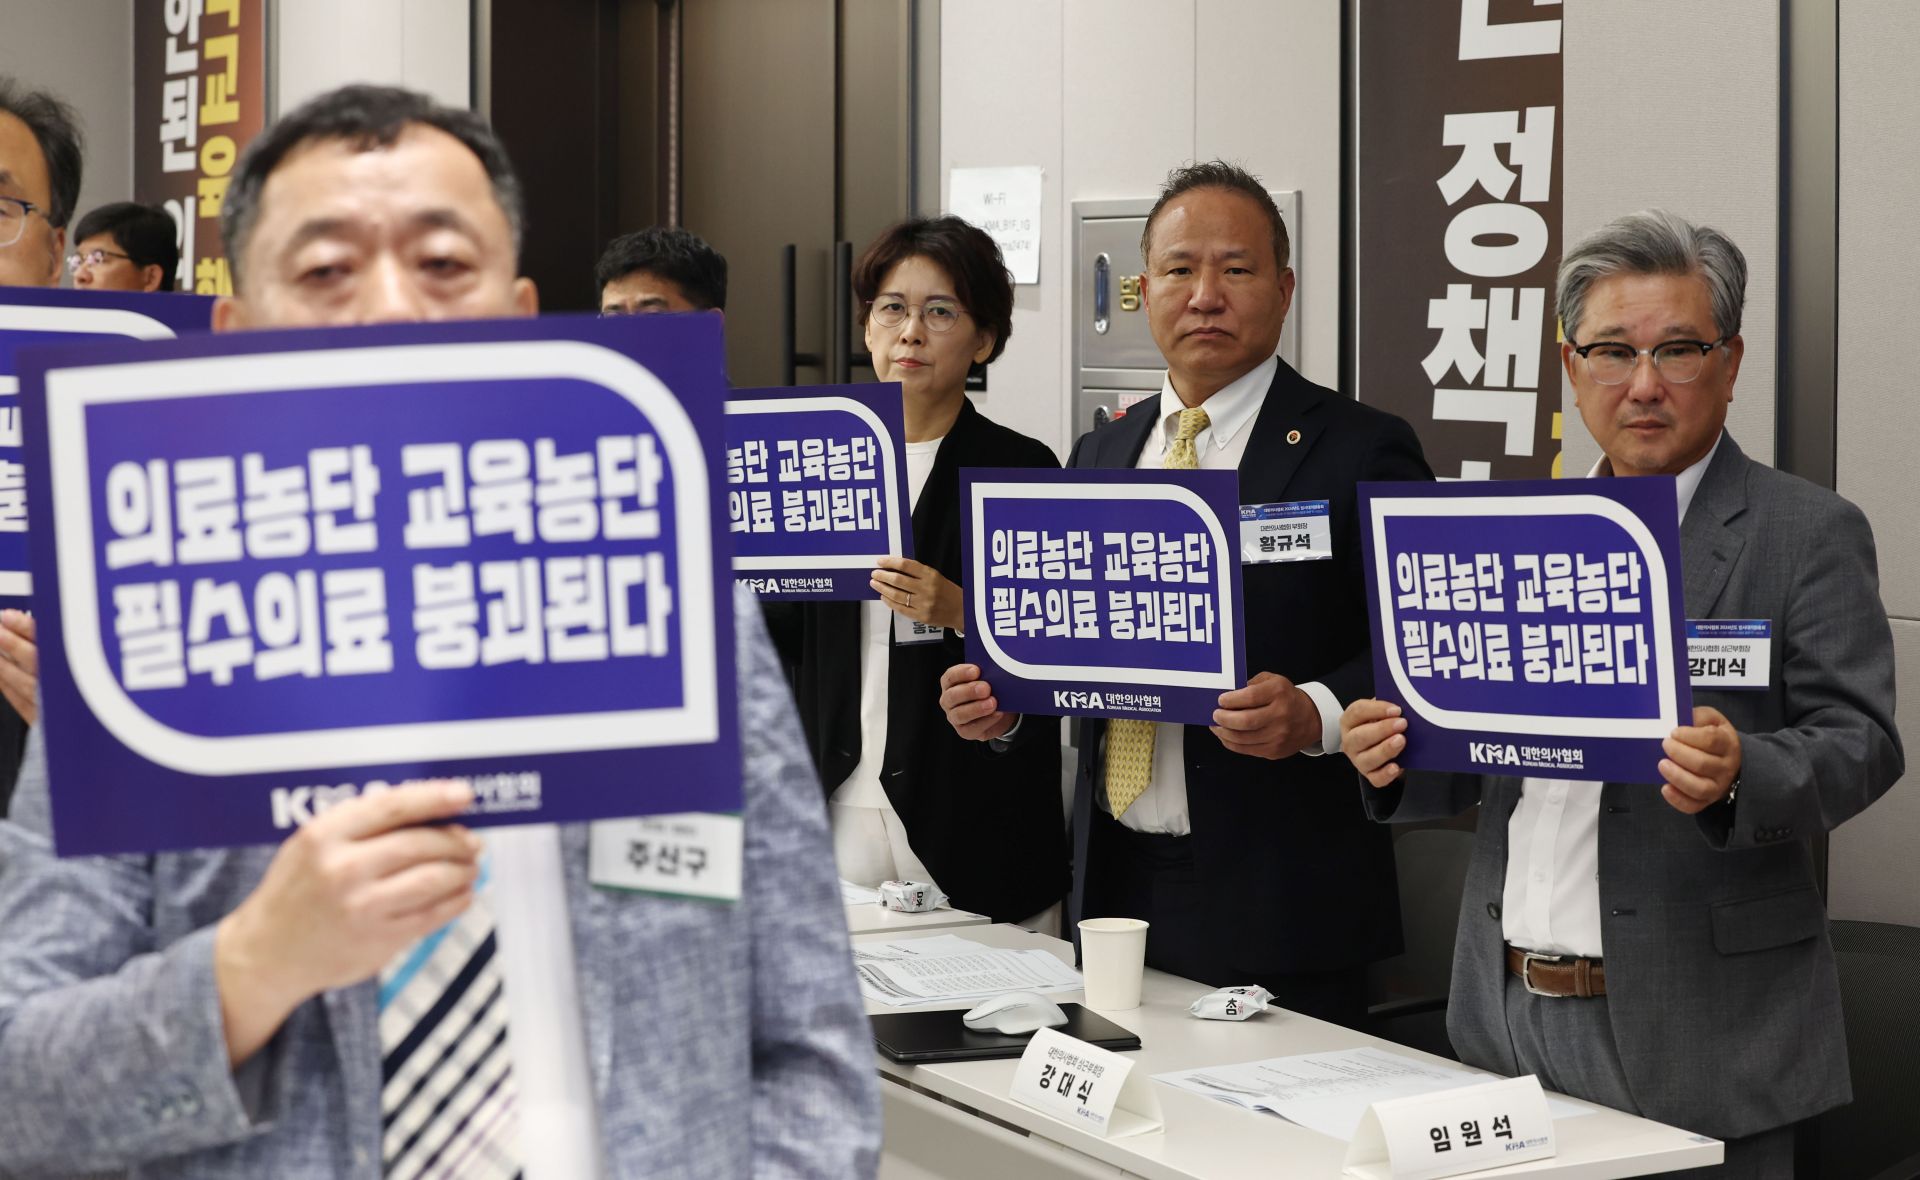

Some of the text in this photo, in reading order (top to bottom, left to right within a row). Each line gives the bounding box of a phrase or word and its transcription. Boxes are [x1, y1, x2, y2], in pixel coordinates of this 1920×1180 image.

[1420, 105, 1556, 481] 정책
[777, 436, 877, 482] 교육농단
[106, 445, 381, 570] 의료농단
[401, 433, 663, 550] 교육농단
[782, 487, 882, 532] 붕괴된다
[990, 529, 1210, 583] 의료농단 교육농단
[1259, 533, 1311, 553] 황규석
[780, 578, 833, 589] 대한의사협회
[1396, 551, 1642, 613] 의료농단 교육농단
[113, 551, 672, 691] 필수의료 붕괴된다
[992, 587, 1215, 644] 필수의료 붕괴된다
[1401, 620, 1649, 685] 필수의료 붕괴된다
[1688, 658, 1746, 677] 강대식
[1053, 690, 1105, 709] KMA
[1105, 693, 1161, 708] 대한의사협회
[1469, 742, 1521, 766] KMA
[1520, 746, 1583, 763] 대한의사협회
